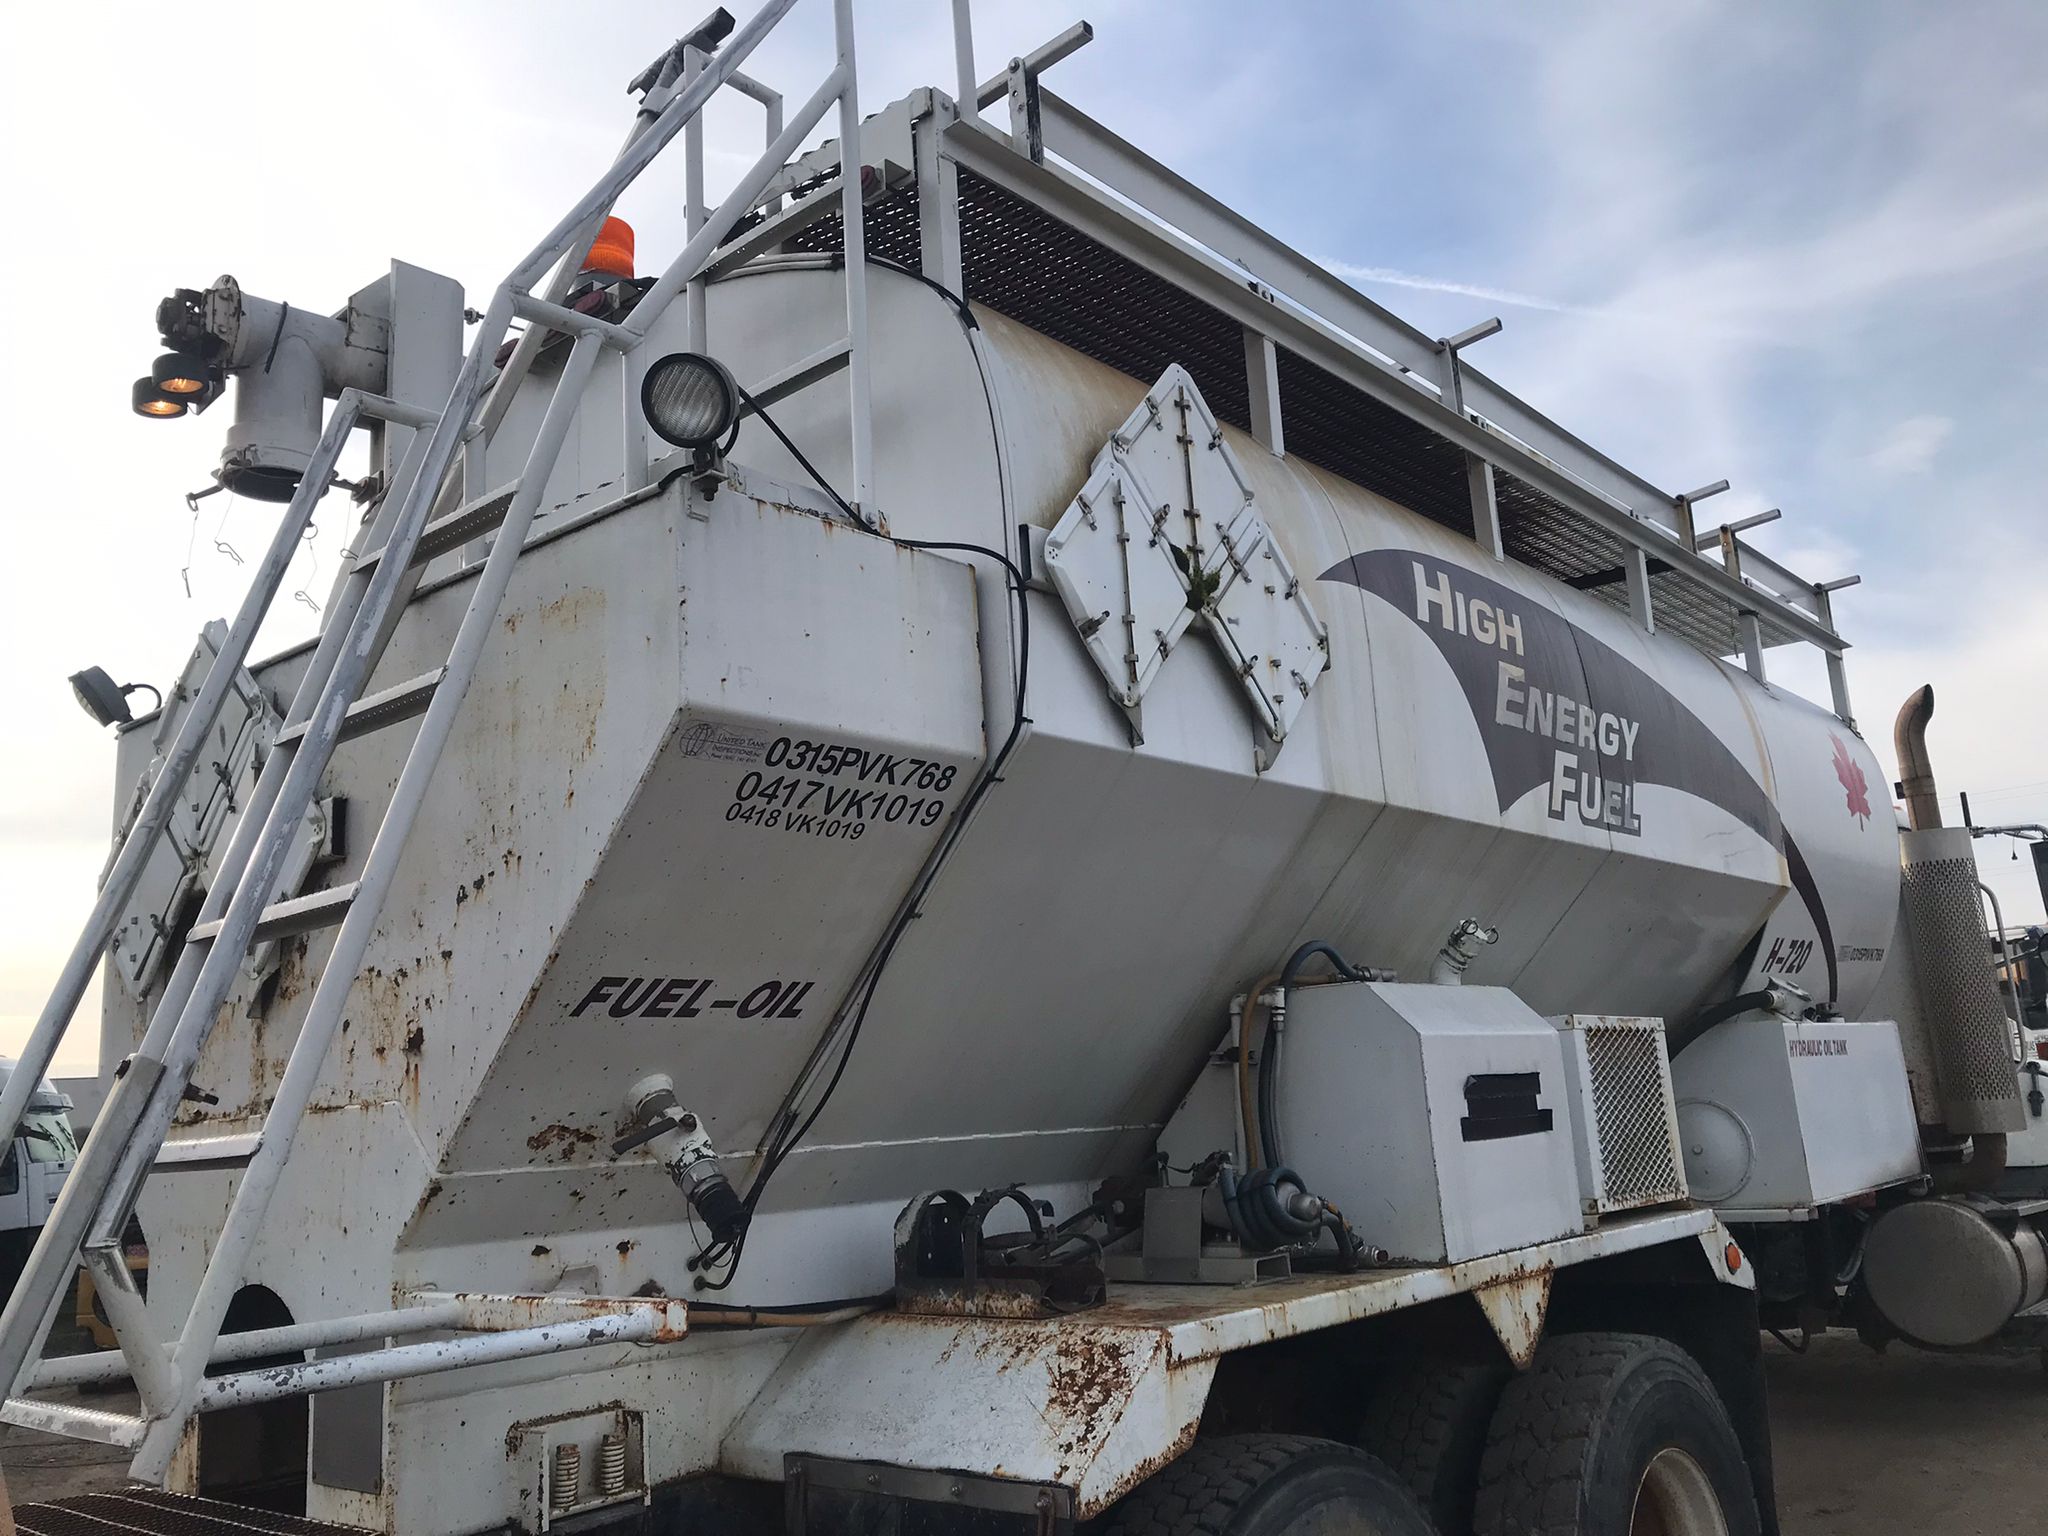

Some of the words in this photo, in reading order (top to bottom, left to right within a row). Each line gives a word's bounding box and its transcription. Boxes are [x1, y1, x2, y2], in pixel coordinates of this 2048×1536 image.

[1411, 560, 1525, 656] HIGH
[1495, 660, 1640, 761] ENERGY
[764, 737, 957, 792] 0315PVK768
[1549, 749, 1641, 834] FUEL
[1761, 937, 1813, 974] H-720
[1789, 1039, 1823, 1057] HYDRAULIC
[1824, 1039, 1833, 1056] OIL
[1833, 1039, 1849, 1056] TANK
